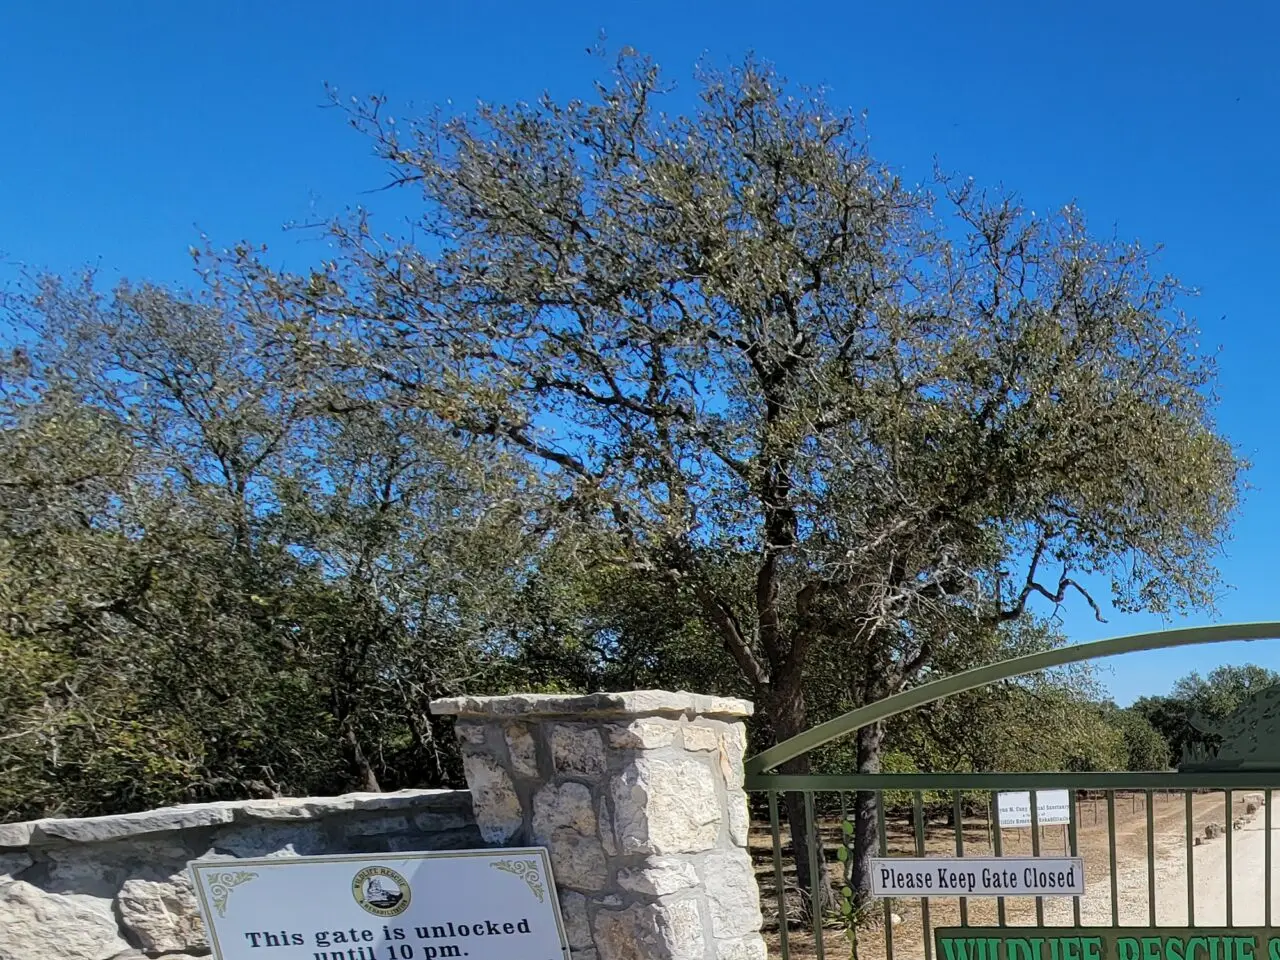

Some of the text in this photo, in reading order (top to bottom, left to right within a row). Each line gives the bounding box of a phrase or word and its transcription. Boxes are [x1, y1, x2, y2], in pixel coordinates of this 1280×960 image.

[881, 867, 1075, 892] Please Keep Gate Closed
[244, 918, 532, 948] This gate is unlocked
[387, 944, 414, 960] 10
